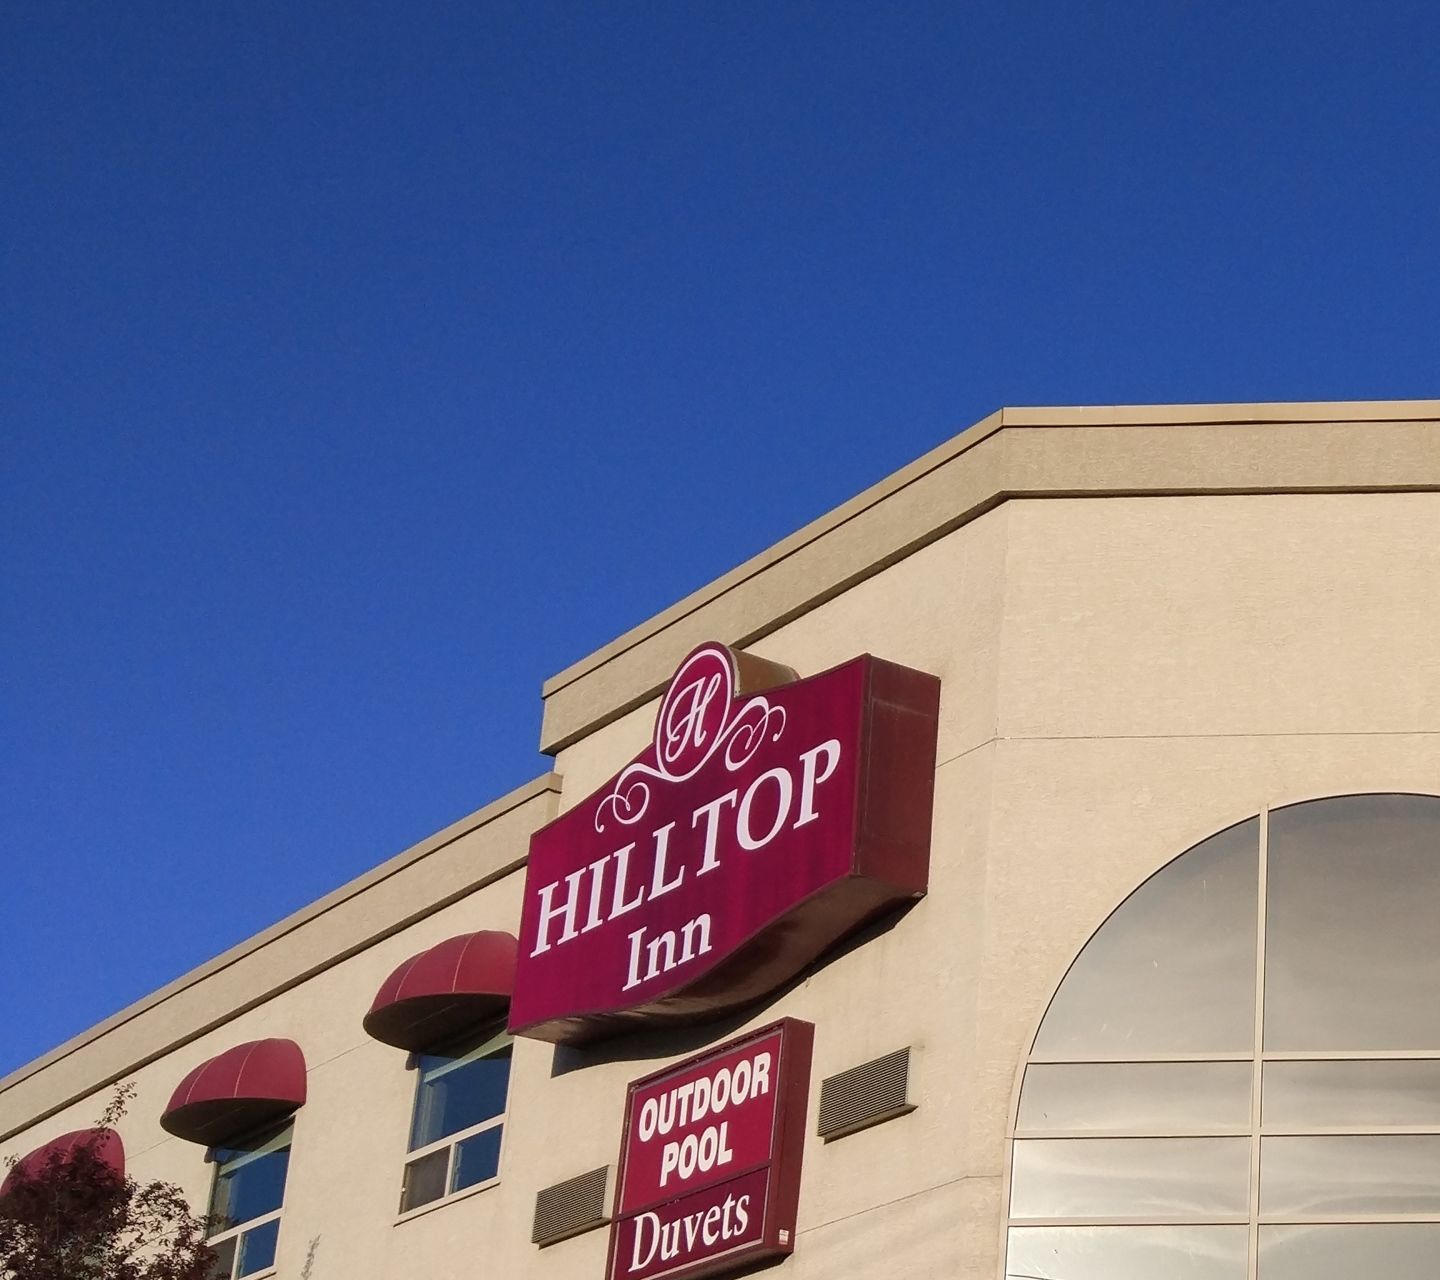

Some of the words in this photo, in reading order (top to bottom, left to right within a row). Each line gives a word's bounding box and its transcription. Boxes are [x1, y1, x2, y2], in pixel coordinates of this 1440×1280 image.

[529, 738, 841, 959] HILLTOP
[621, 913, 713, 992] Inn
[638, 1052, 771, 1142] OUTDOOR
[659, 1121, 733, 1188] POOL
[628, 1193, 750, 1273] Duvets
